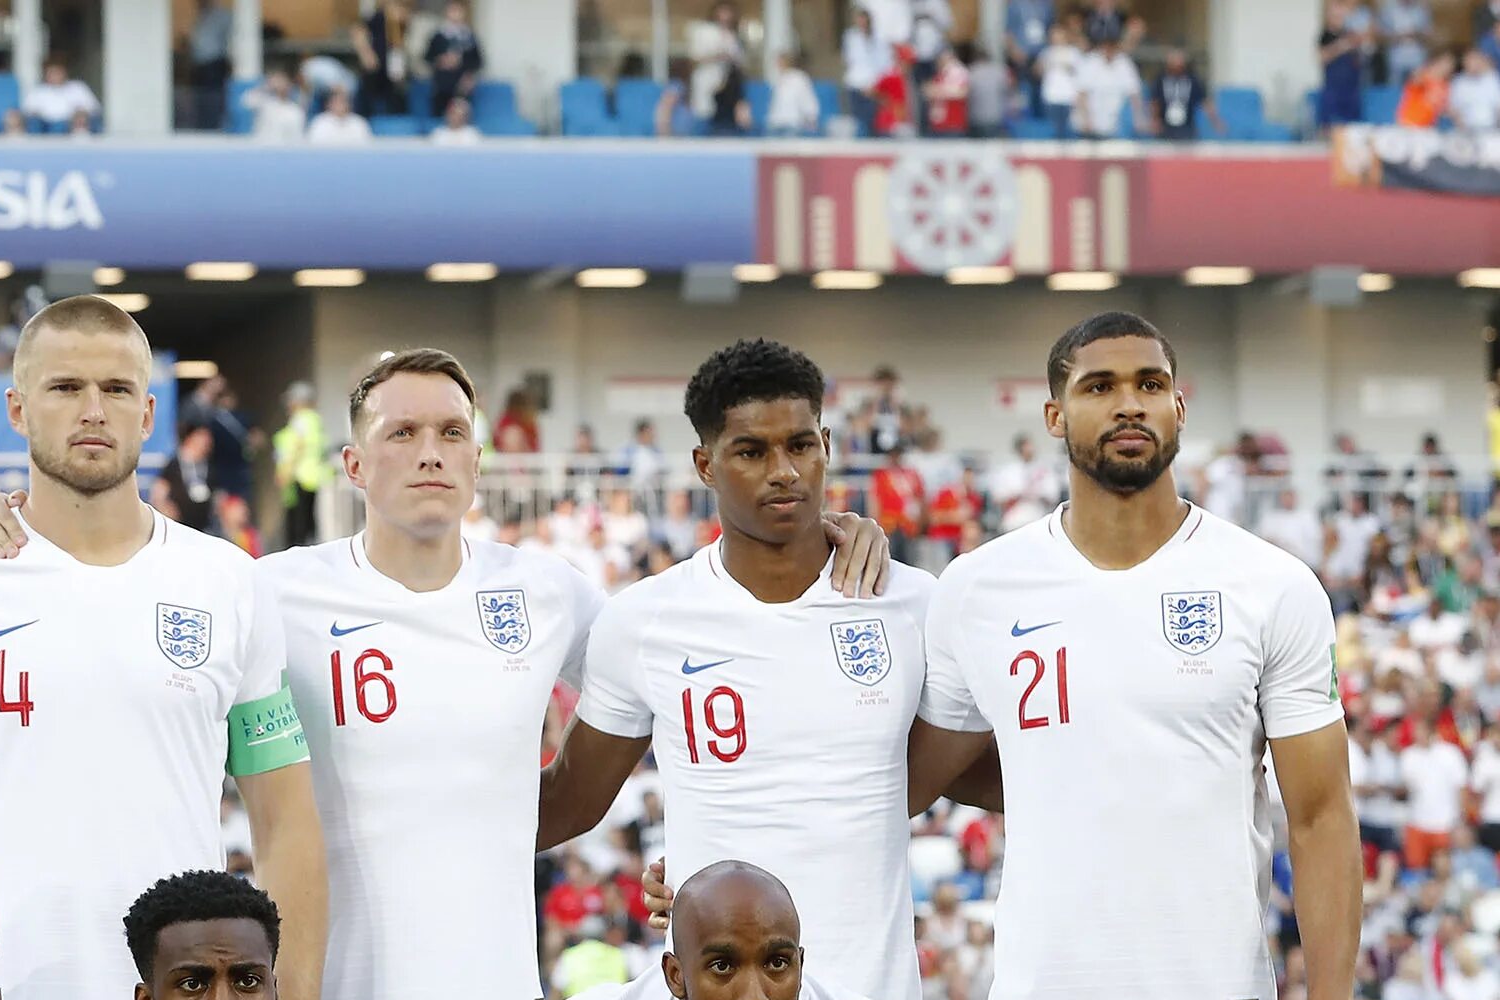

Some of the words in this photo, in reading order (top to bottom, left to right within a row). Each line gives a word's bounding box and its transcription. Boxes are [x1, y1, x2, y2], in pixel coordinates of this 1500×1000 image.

[330, 646, 398, 727] 16
[681, 685, 749, 765] 19
[1010, 646, 1071, 730] 21
